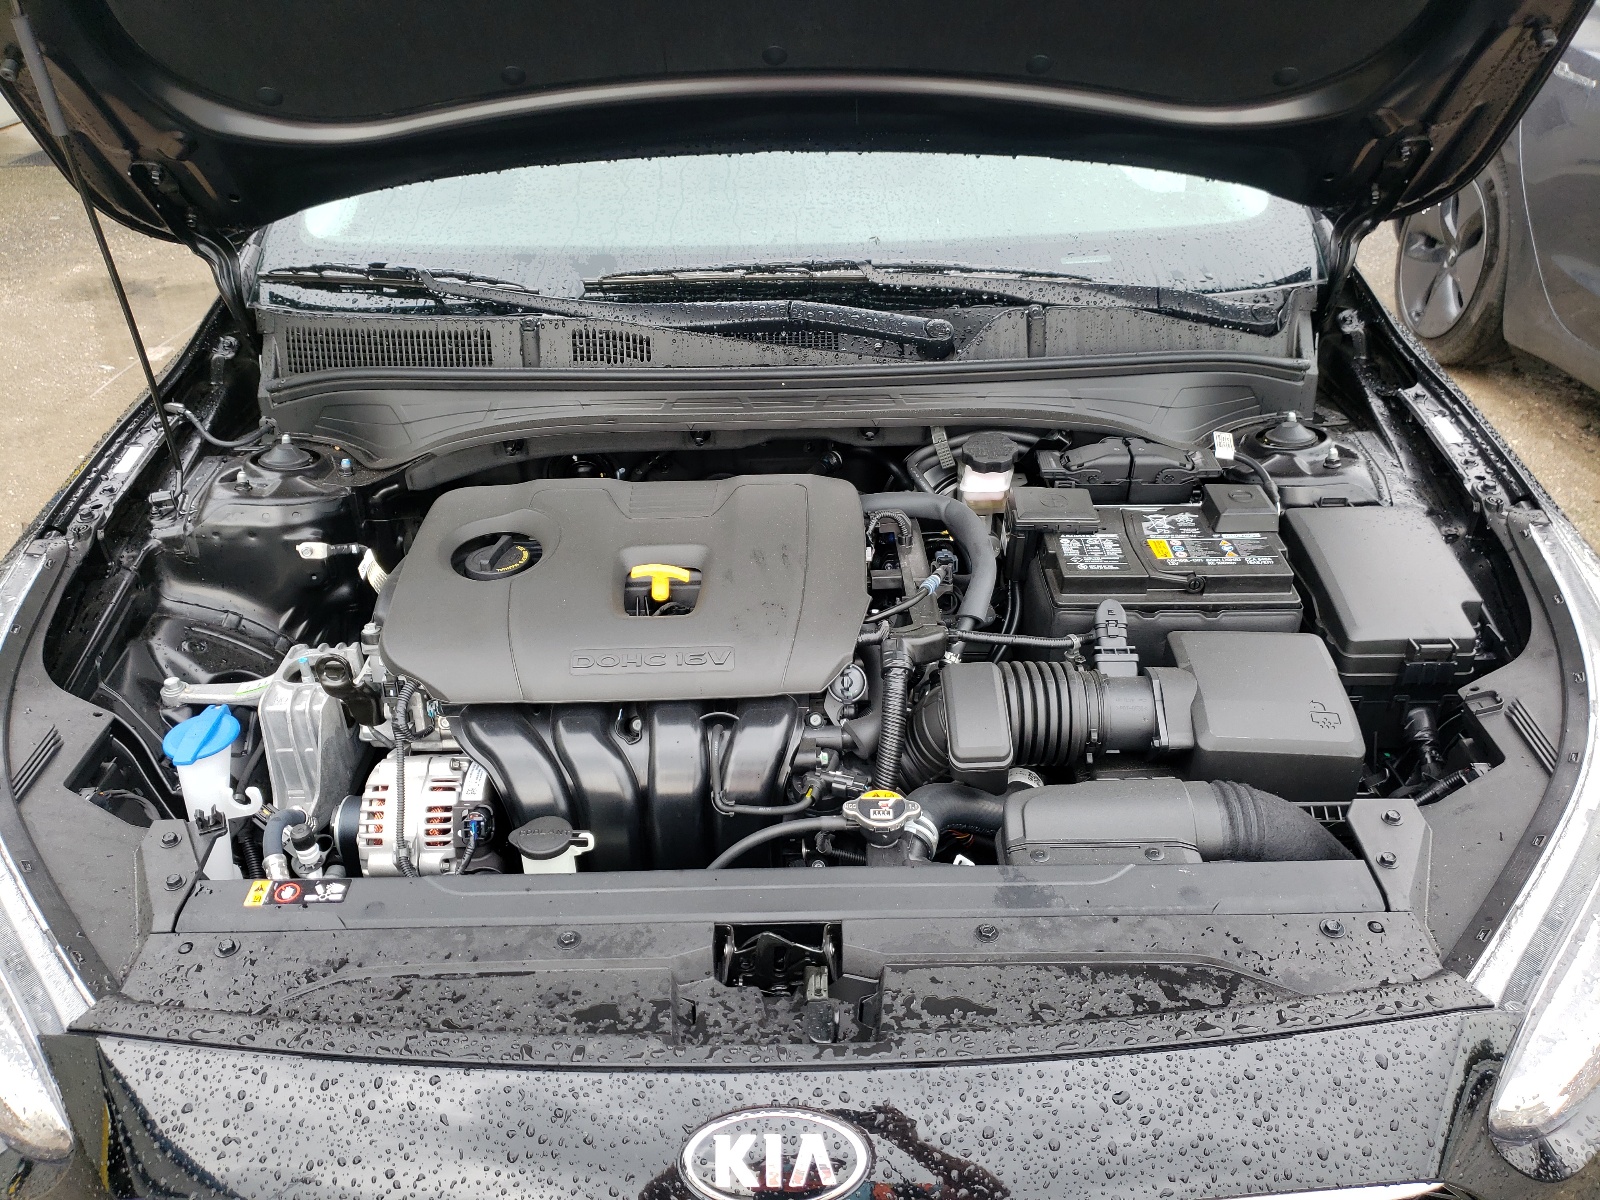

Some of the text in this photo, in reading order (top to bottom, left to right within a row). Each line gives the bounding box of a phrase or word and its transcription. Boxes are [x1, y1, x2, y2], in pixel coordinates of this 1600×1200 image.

[571, 650, 732, 669] DOHC 16V
[519, 829, 571, 837] COOLANT
[713, 1133, 837, 1188] KIA
